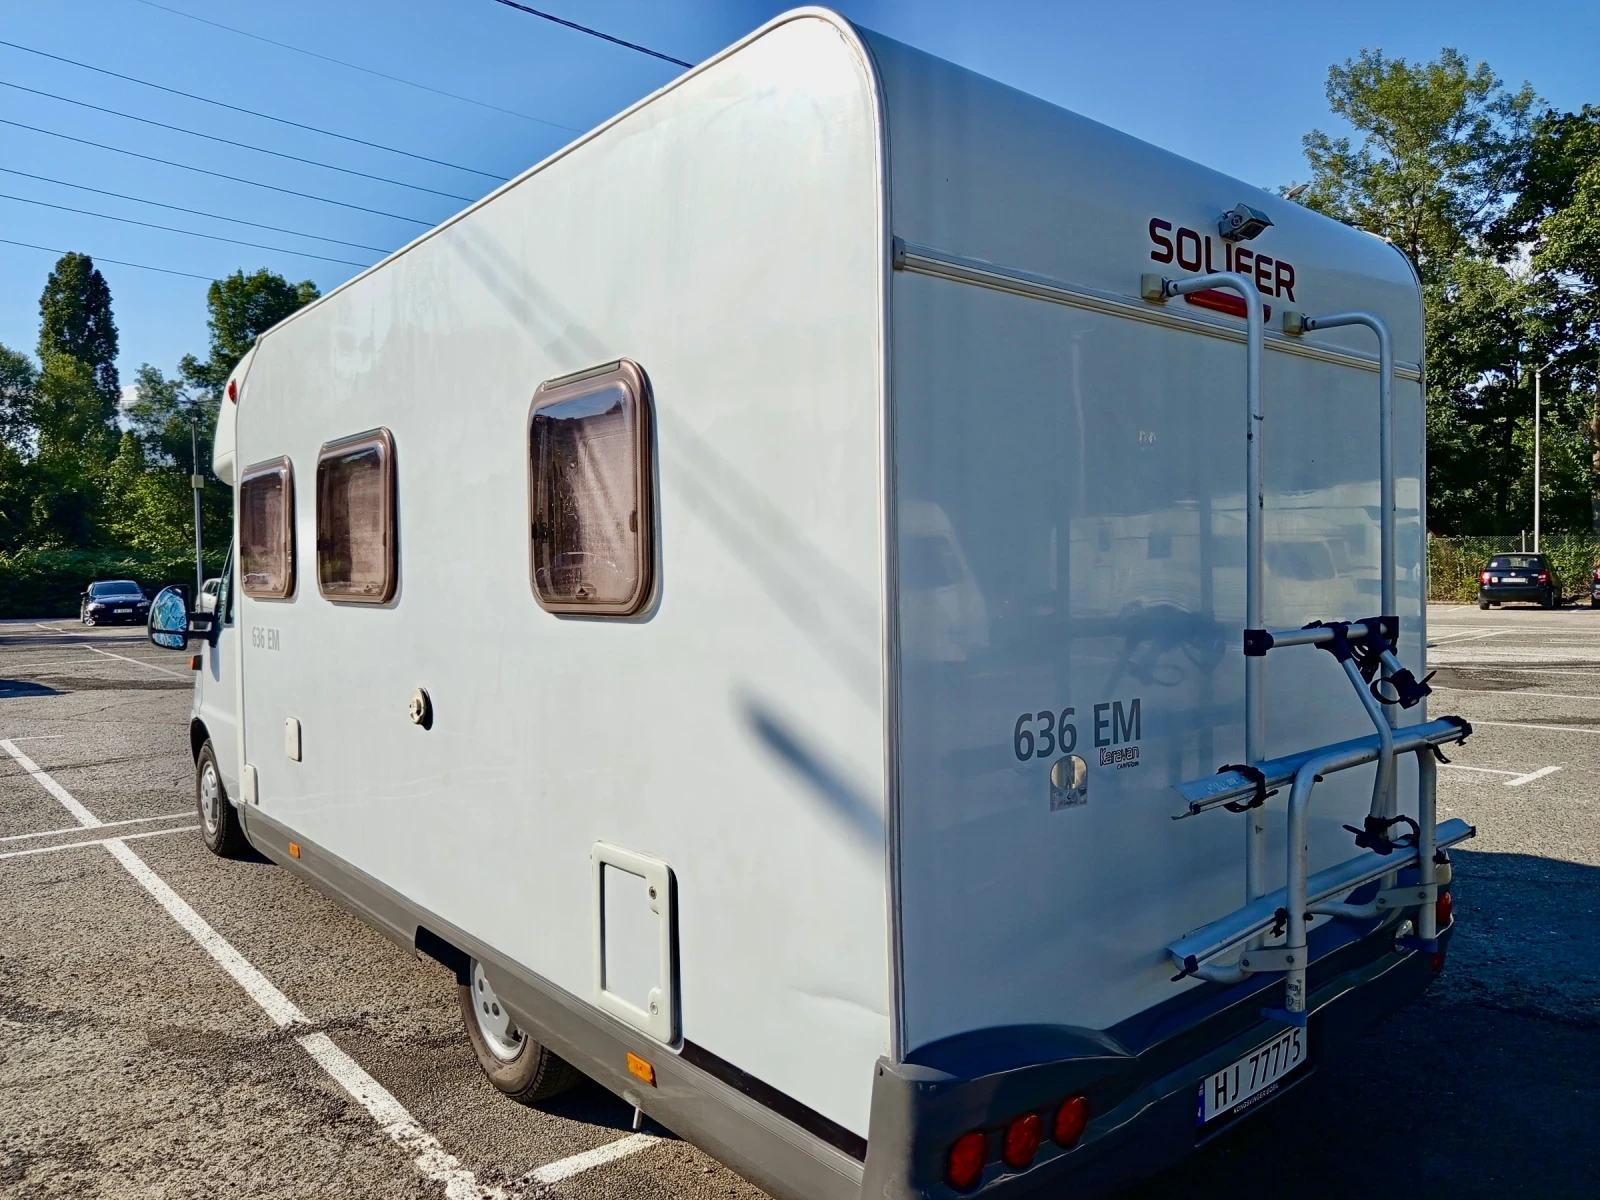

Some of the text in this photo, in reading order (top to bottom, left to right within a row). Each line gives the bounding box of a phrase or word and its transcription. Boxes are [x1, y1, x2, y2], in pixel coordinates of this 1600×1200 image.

[1149, 217, 1296, 302] SOLIFER
[252, 626, 280, 651] 636 EM
[1014, 698, 1141, 761] 636 EM
[1099, 746, 1139, 766] Karavan
[1214, 1028, 1301, 1110] HJ 77775
